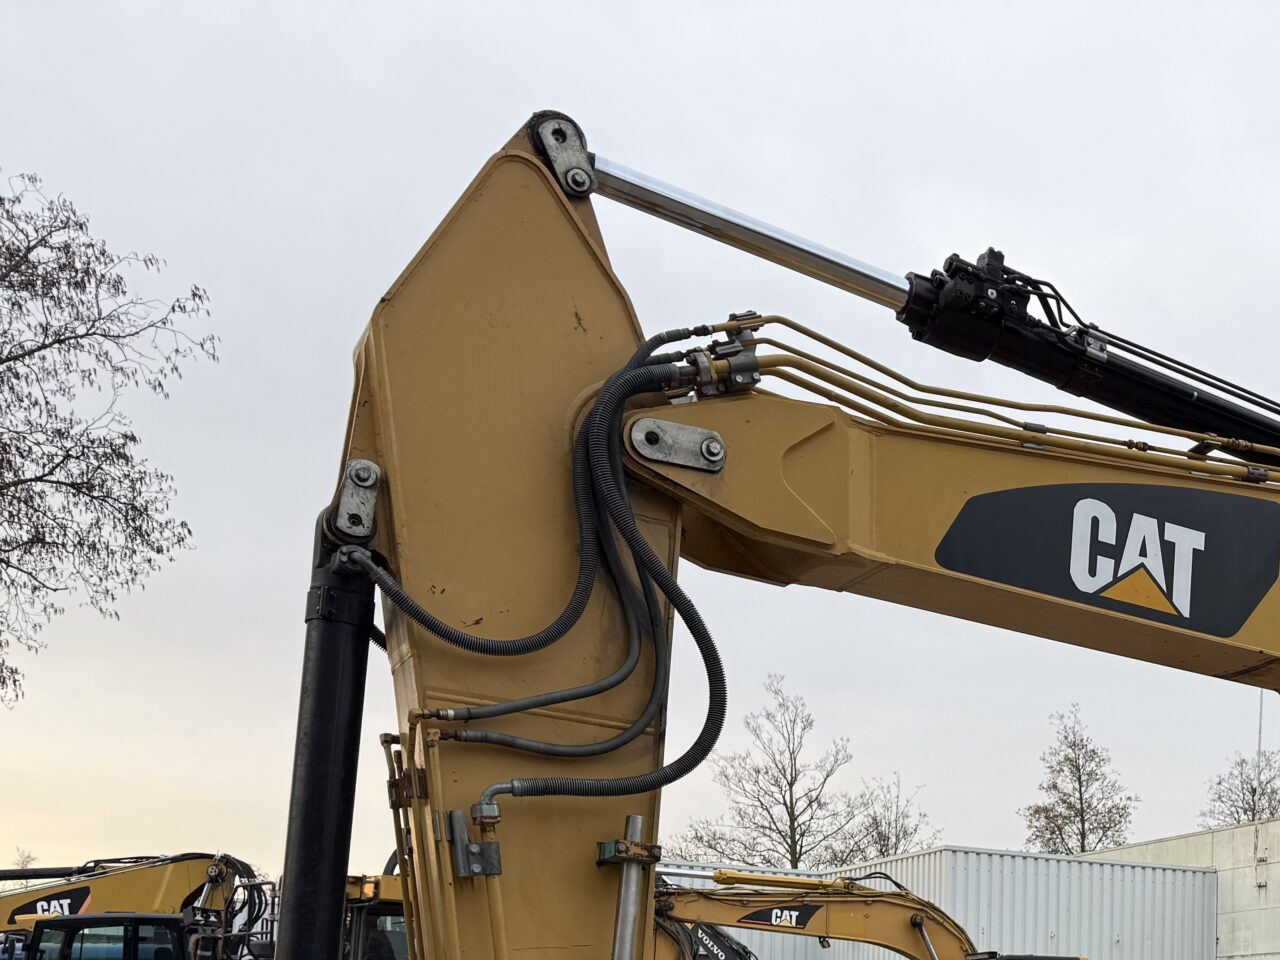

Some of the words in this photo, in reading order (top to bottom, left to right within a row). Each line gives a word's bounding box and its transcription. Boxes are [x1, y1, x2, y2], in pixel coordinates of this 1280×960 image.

[1069, 497, 1206, 619] CAT
[36, 899, 71, 916] CAT
[771, 908, 799, 928] CAT
[697, 928, 726, 960] VOLVO
